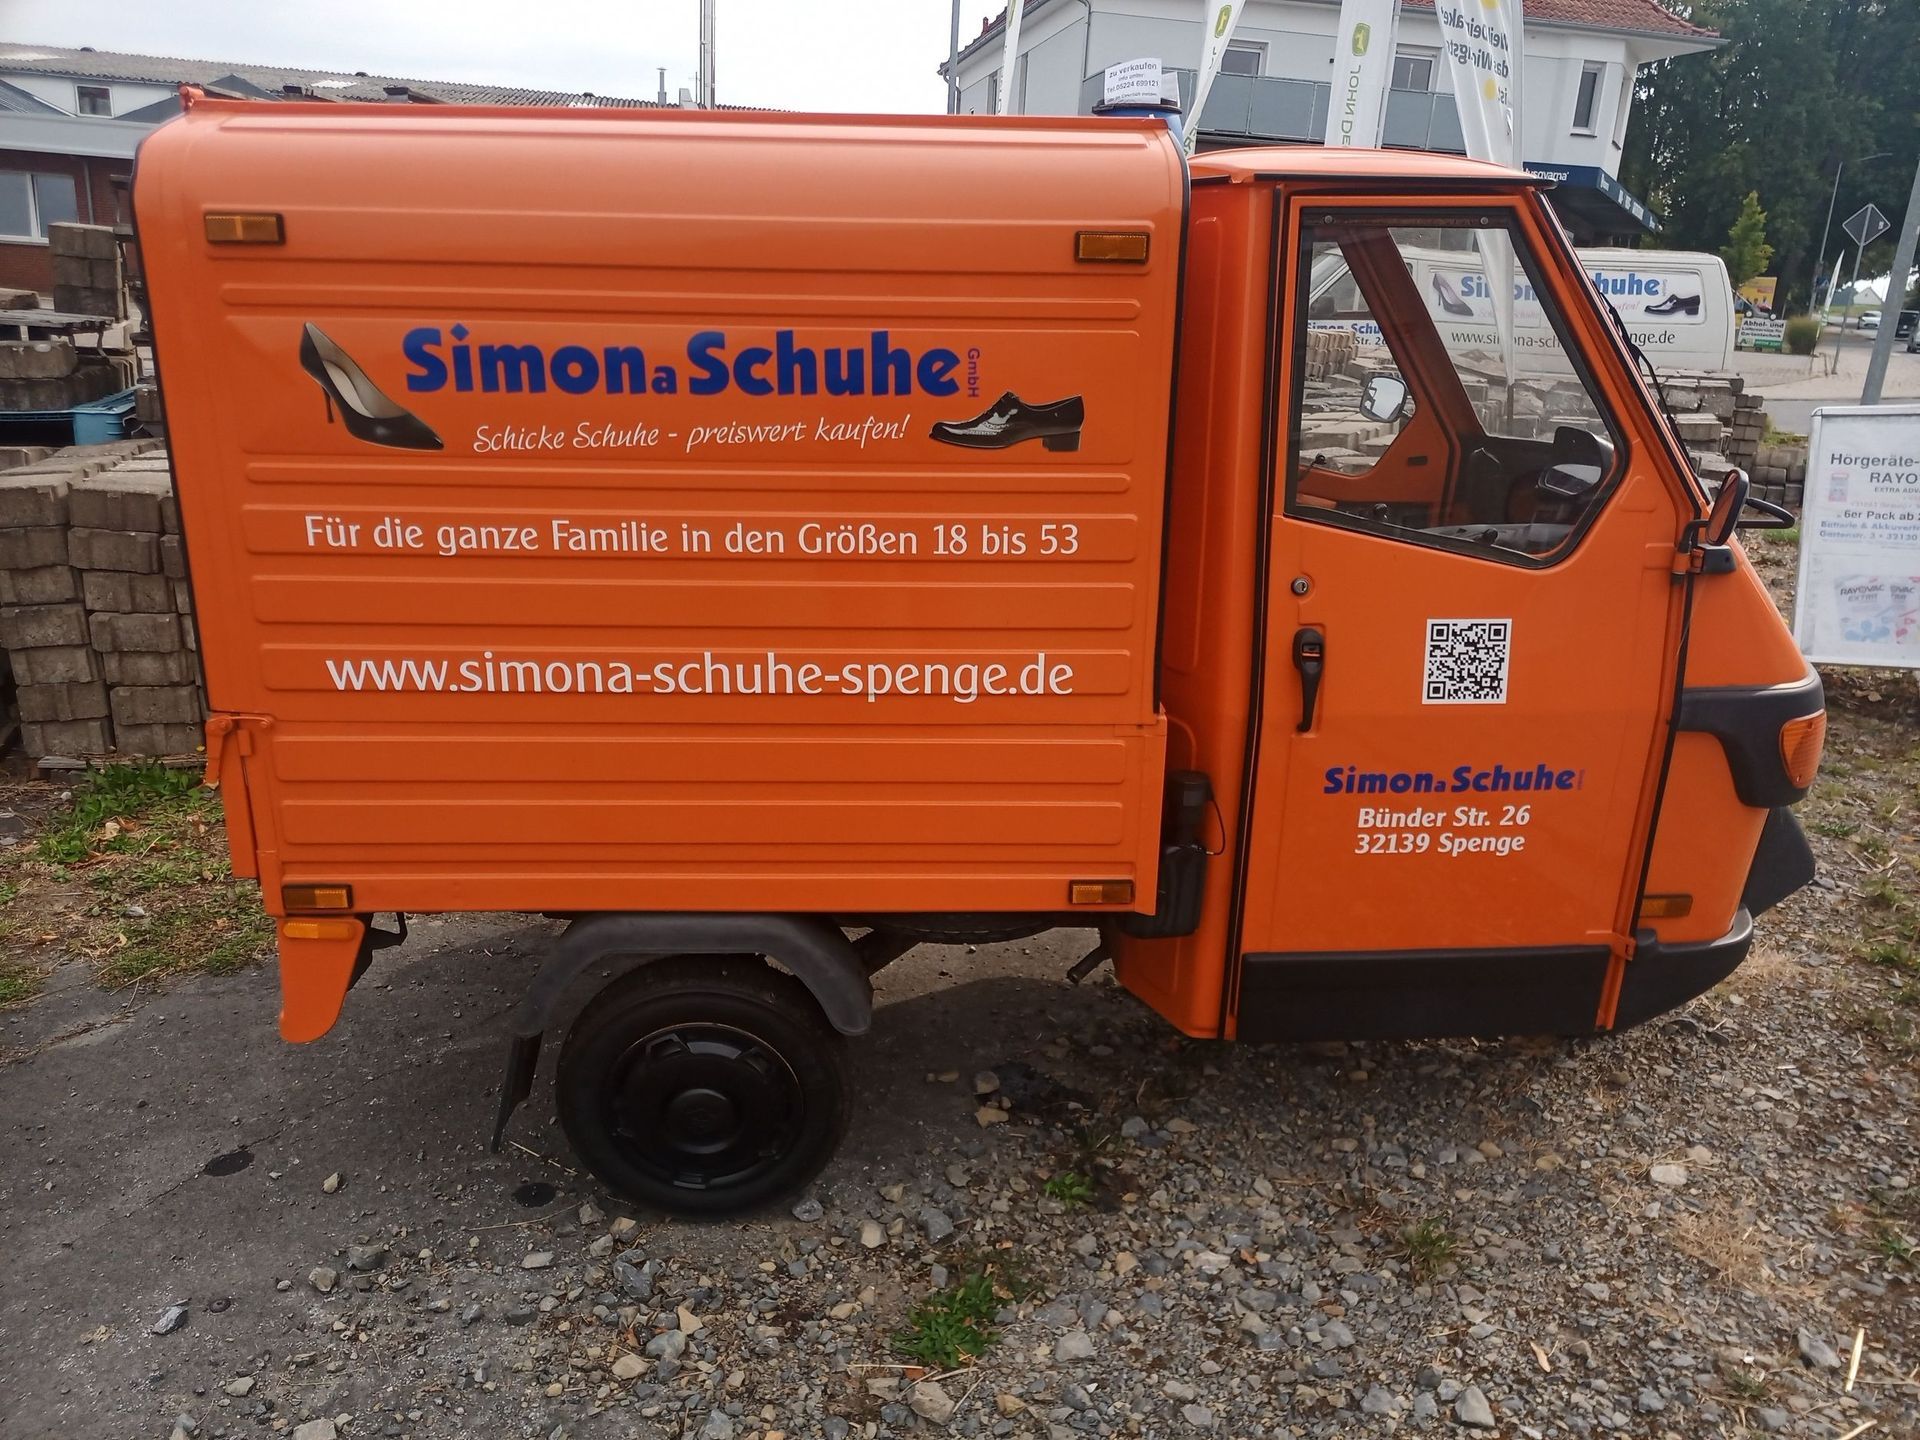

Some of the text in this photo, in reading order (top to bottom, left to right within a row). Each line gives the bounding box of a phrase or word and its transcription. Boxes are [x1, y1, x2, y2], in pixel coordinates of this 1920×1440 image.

[1119, 62, 1157, 74] verkaufen
[686, 330, 961, 398] Schuhe
[967, 347, 981, 398] GmbH
[472, 425, 565, 454] Schicke
[572, 422, 660, 450] Schuhe
[686, 420, 807, 454] preiswert
[814, 413, 911, 450] kaufen!
[1830, 453, 1919, 469] Hörgeräte-
[1843, 510, 1862, 519] 6er
[1866, 510, 1896, 521] Pack
[1898, 511, 1914, 521] ab
[305, 515, 1079, 557] Für die ganze Familie in den Größen 18 bis 53
[325, 650, 1074, 704] www.simona-schuhe-spenge.de
[1451, 763, 1576, 793] Schuhe
[1357, 804, 1532, 829] Bünder Str. 26
[1354, 832, 1526, 857] 32139 Spenge
